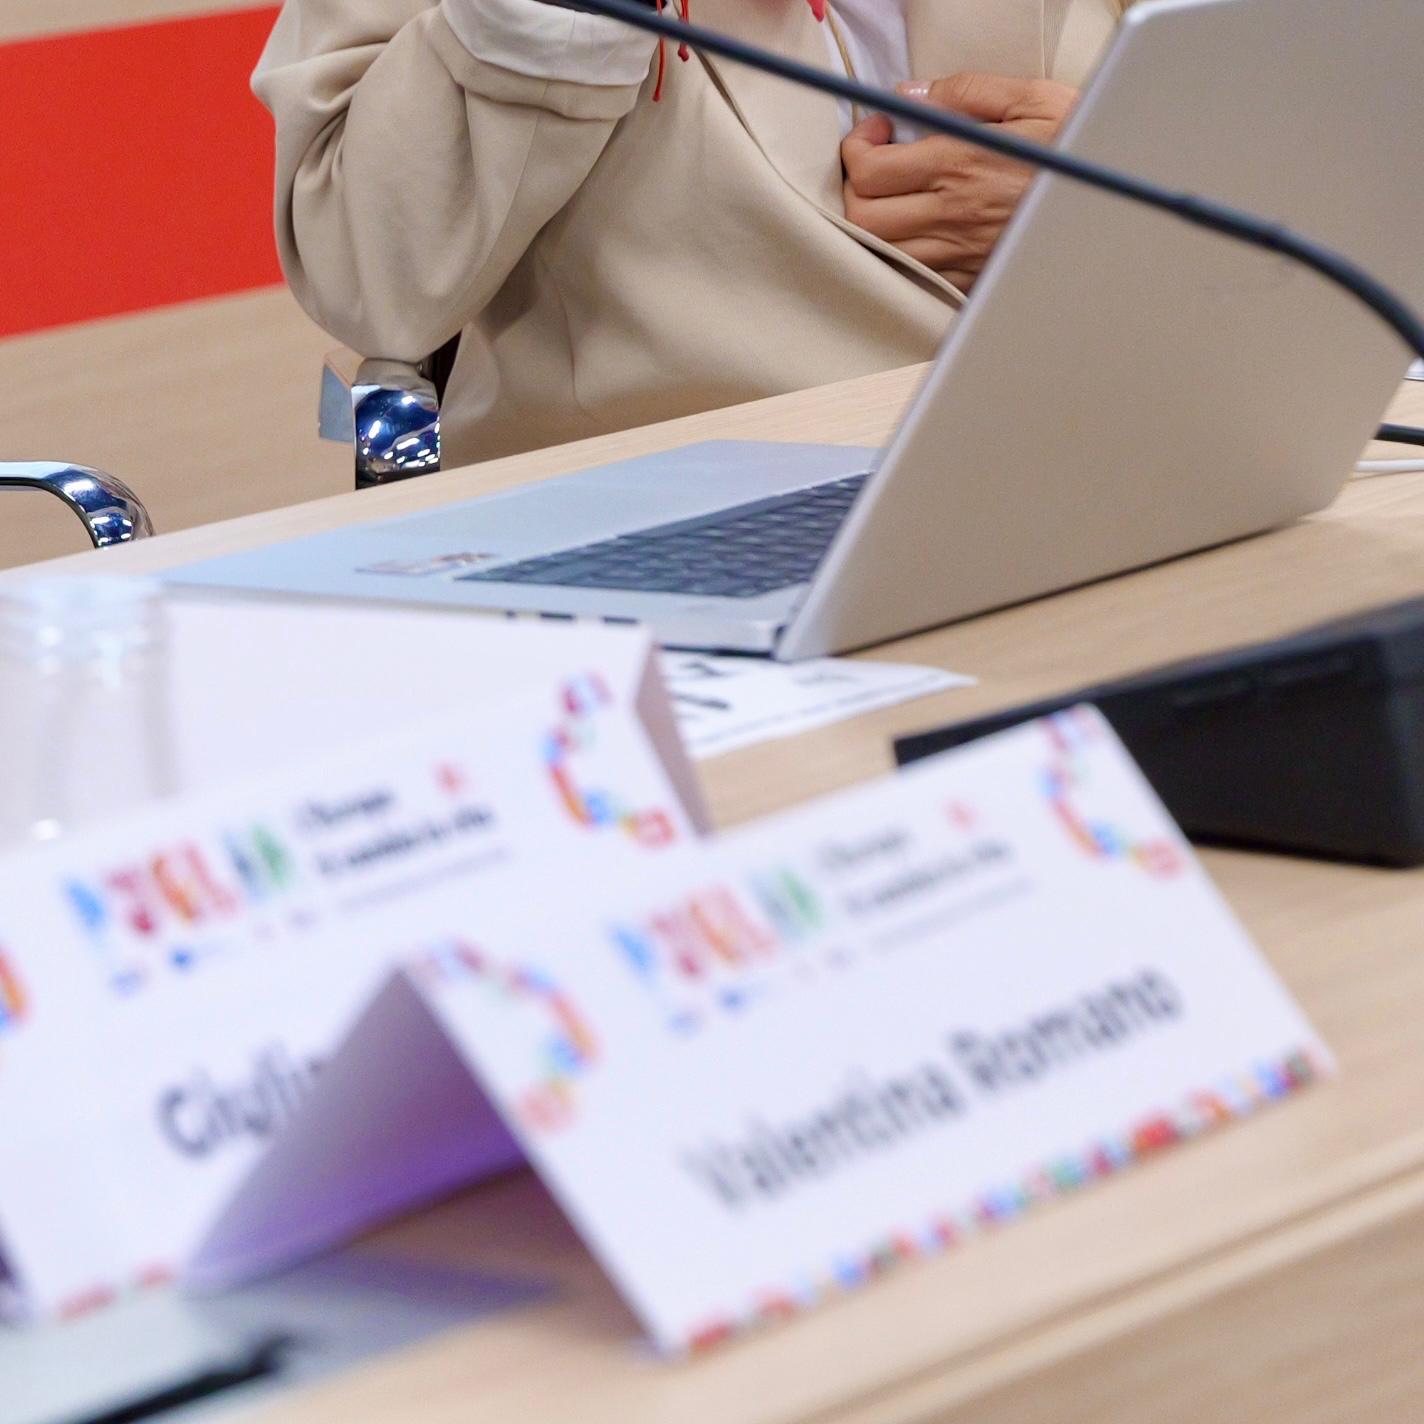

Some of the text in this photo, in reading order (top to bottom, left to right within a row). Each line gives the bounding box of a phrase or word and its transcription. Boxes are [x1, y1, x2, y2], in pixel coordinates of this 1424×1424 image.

[157, 1043, 325, 1158] Giuli
[680, 970, 1186, 1210] Valentina Romano
